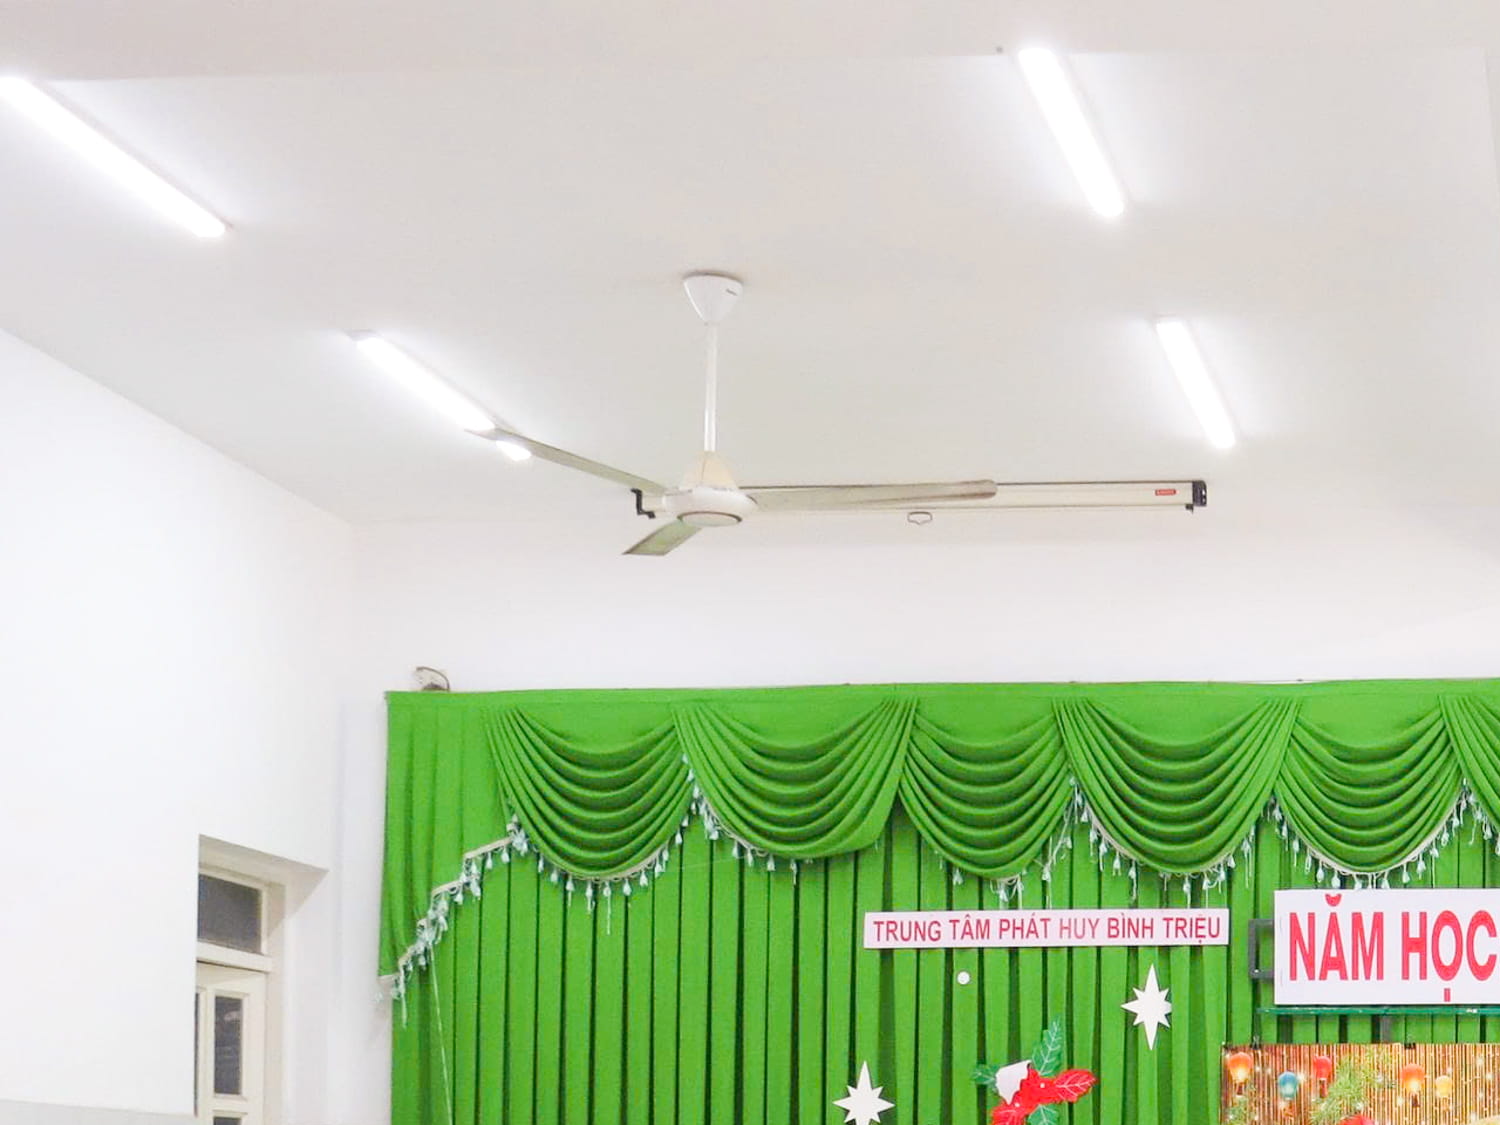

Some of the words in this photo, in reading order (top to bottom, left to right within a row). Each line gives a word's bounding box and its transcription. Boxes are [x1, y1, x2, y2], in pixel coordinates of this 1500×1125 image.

[873, 920, 942, 942] TRUNG
[949, 914, 991, 940] TÂM
[999, 912, 1051, 939] PHÁT
[1060, 917, 1100, 939] HUY
[1107, 912, 1153, 939] BÌNH
[1289, 893, 1385, 981] NĂM
